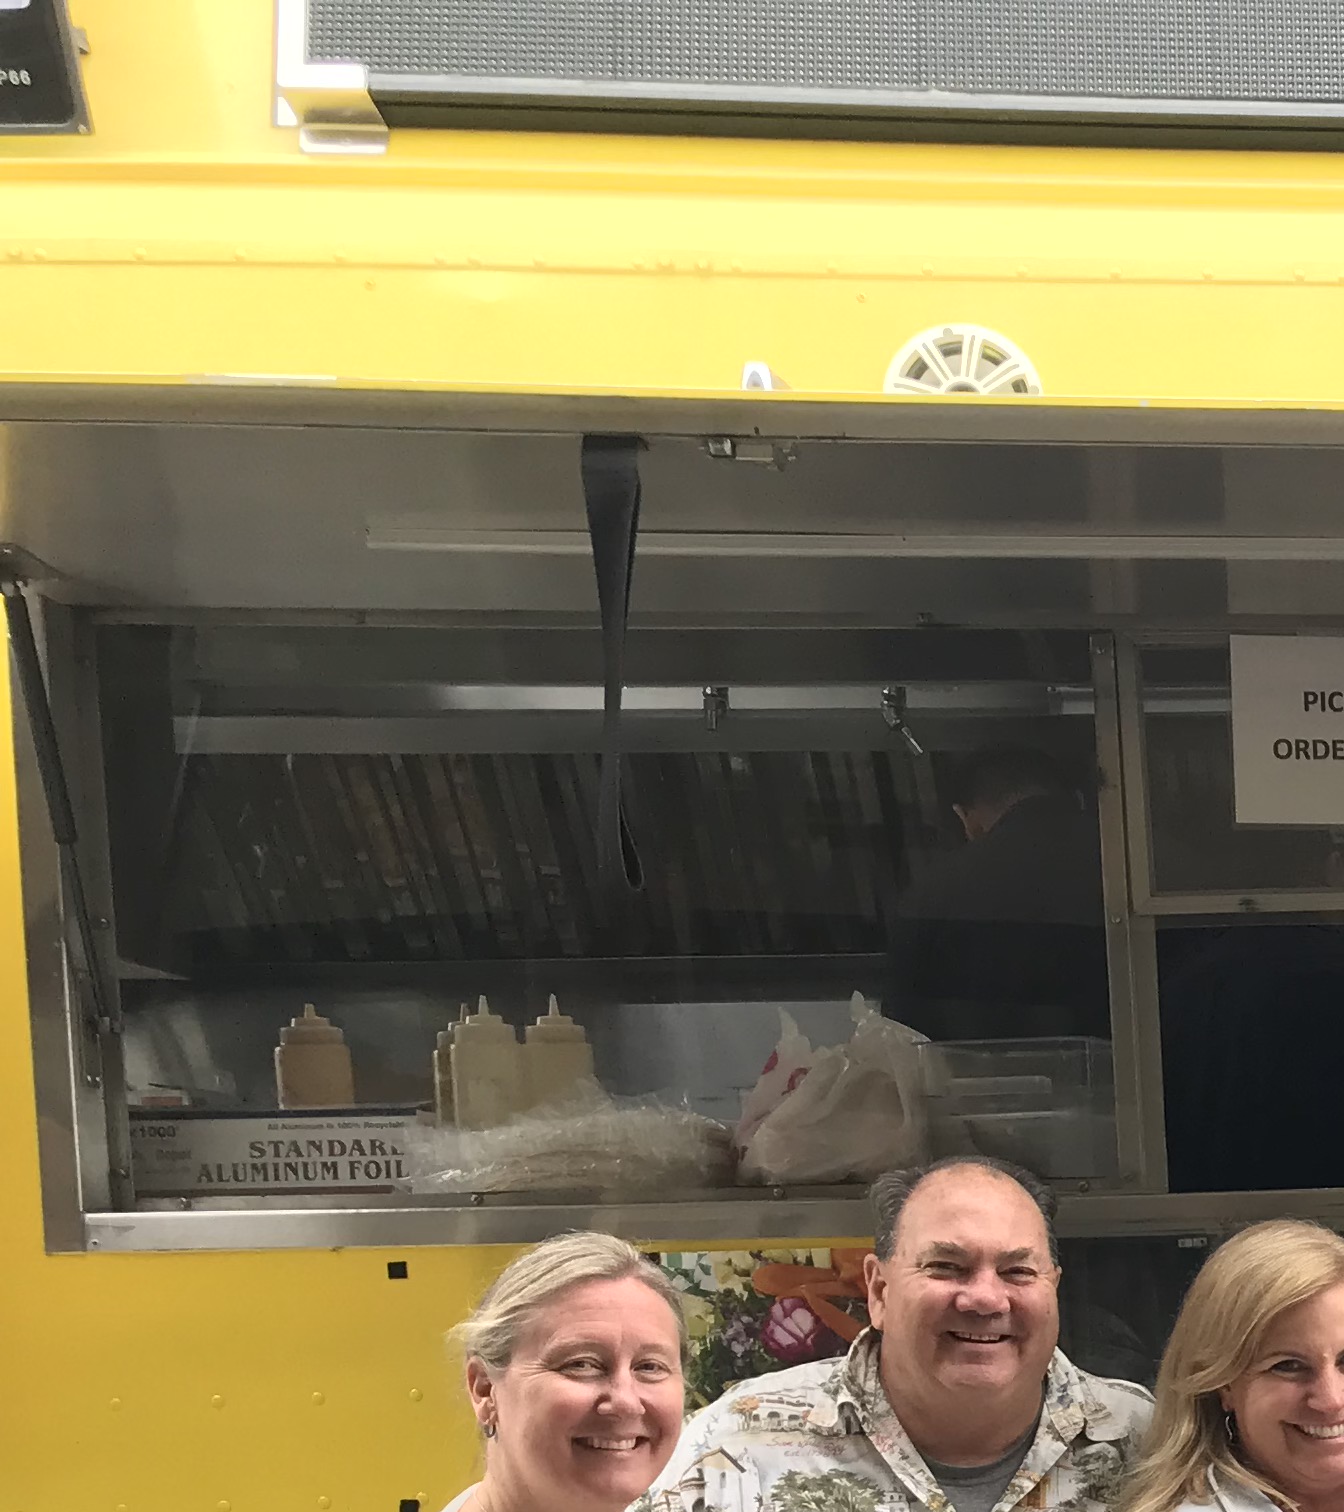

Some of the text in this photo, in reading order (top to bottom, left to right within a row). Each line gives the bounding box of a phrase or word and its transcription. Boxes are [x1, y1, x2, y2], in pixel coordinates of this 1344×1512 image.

[249, 1138, 405, 1159] STANDAR
[197, 1159, 410, 1183] ALUMINUM FOIL
